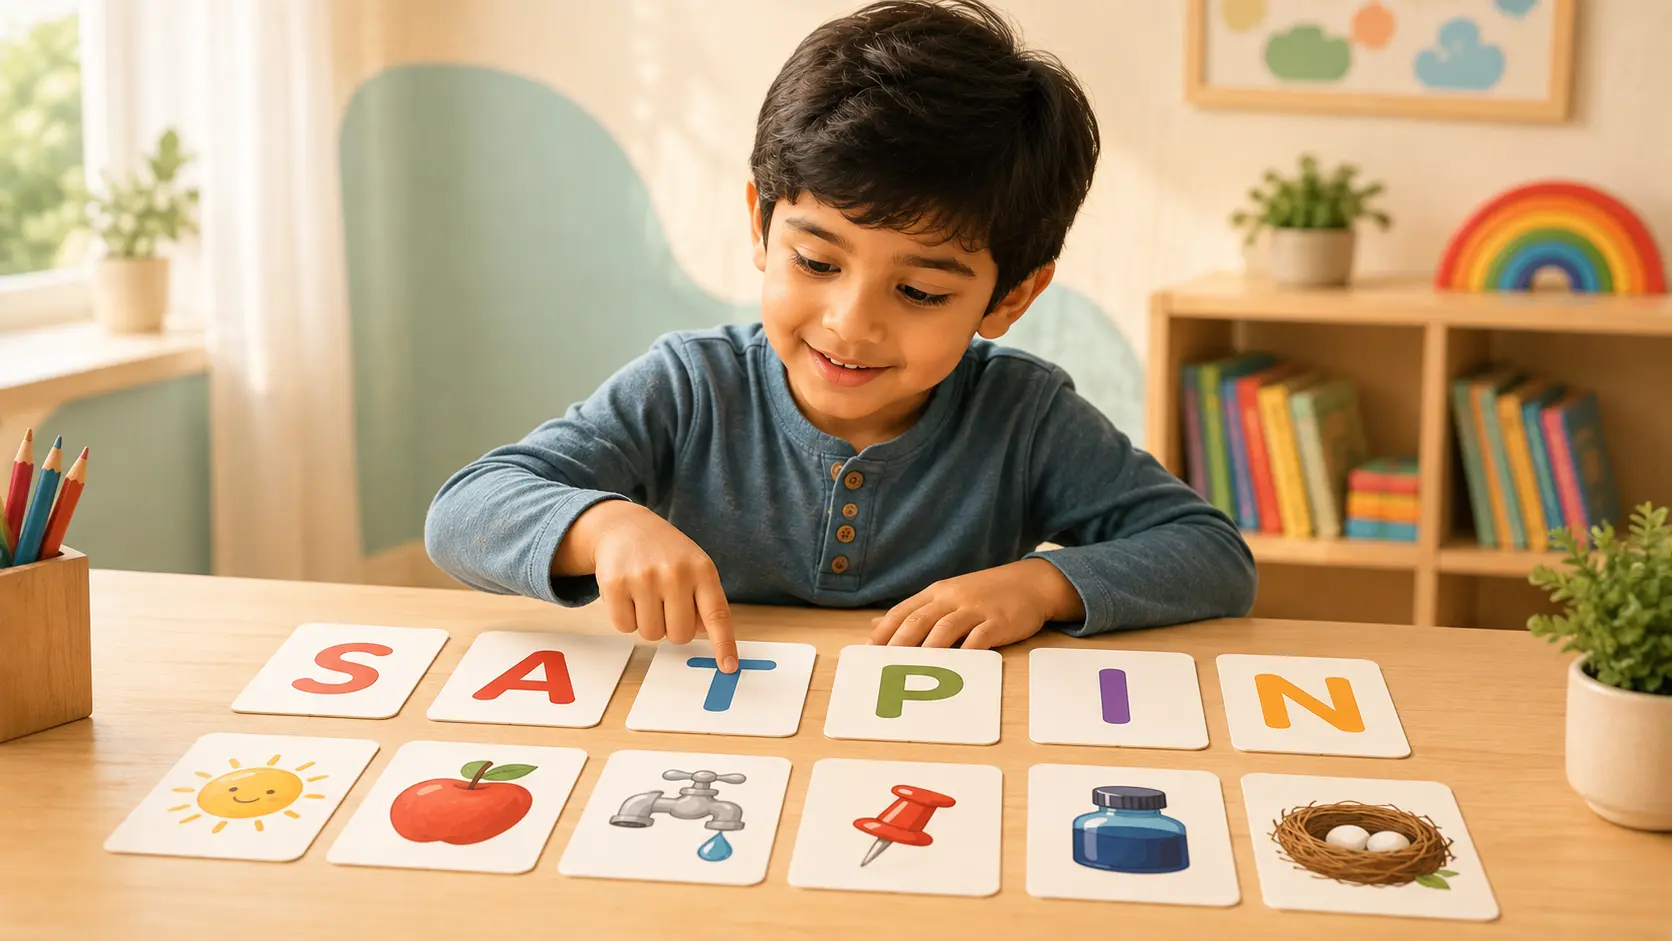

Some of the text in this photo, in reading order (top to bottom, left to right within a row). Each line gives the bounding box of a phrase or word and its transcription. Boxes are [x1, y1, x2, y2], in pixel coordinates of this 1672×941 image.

[292, 642, 393, 695] S
[472, 649, 576, 705] A
[686, 656, 777, 712] T
[875, 665, 964, 719] P
[1099, 667, 1131, 725] I
[1254, 673, 1366, 733] N
